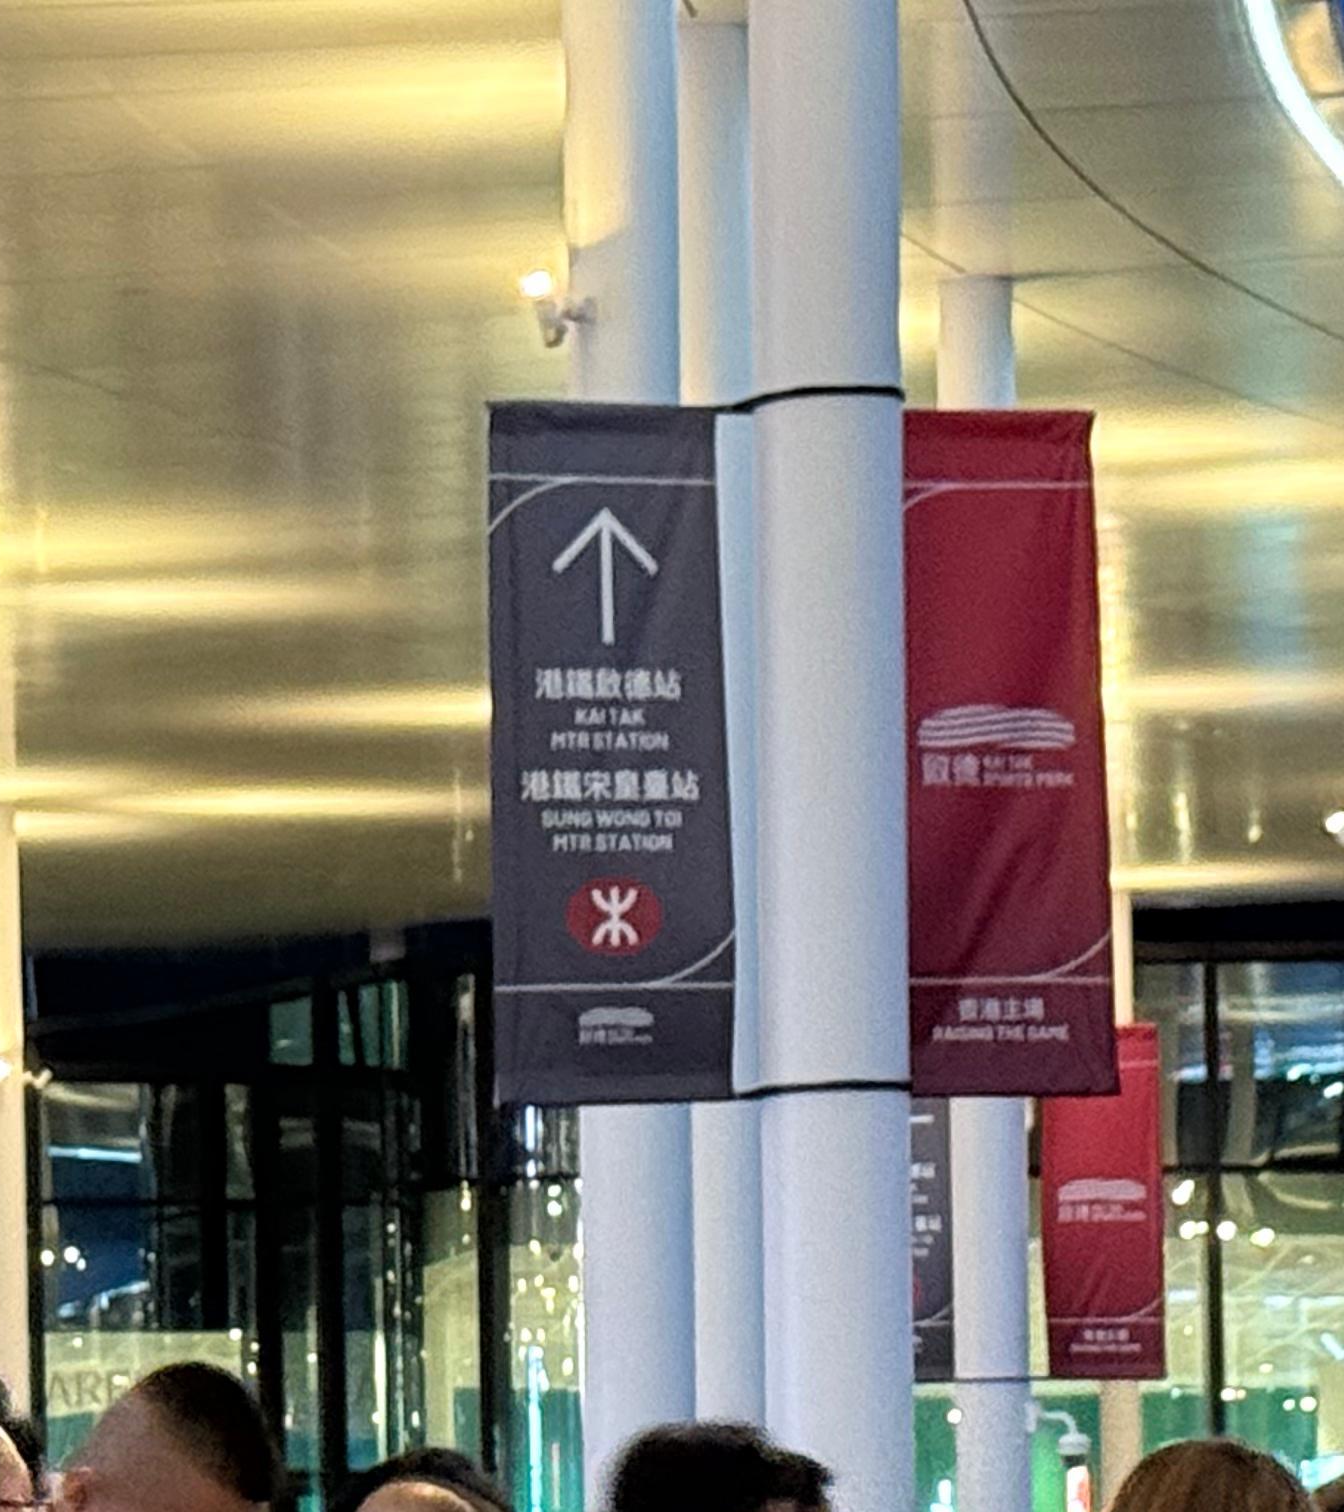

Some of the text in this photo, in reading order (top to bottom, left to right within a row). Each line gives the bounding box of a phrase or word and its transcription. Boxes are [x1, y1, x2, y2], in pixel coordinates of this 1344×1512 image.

[573, 707, 646, 726] KAI TAK
[550, 731, 670, 750] MTR STATION
[540, 808, 684, 829] SUNG WONG TOI
[552, 833, 674, 852] MTR STATION
